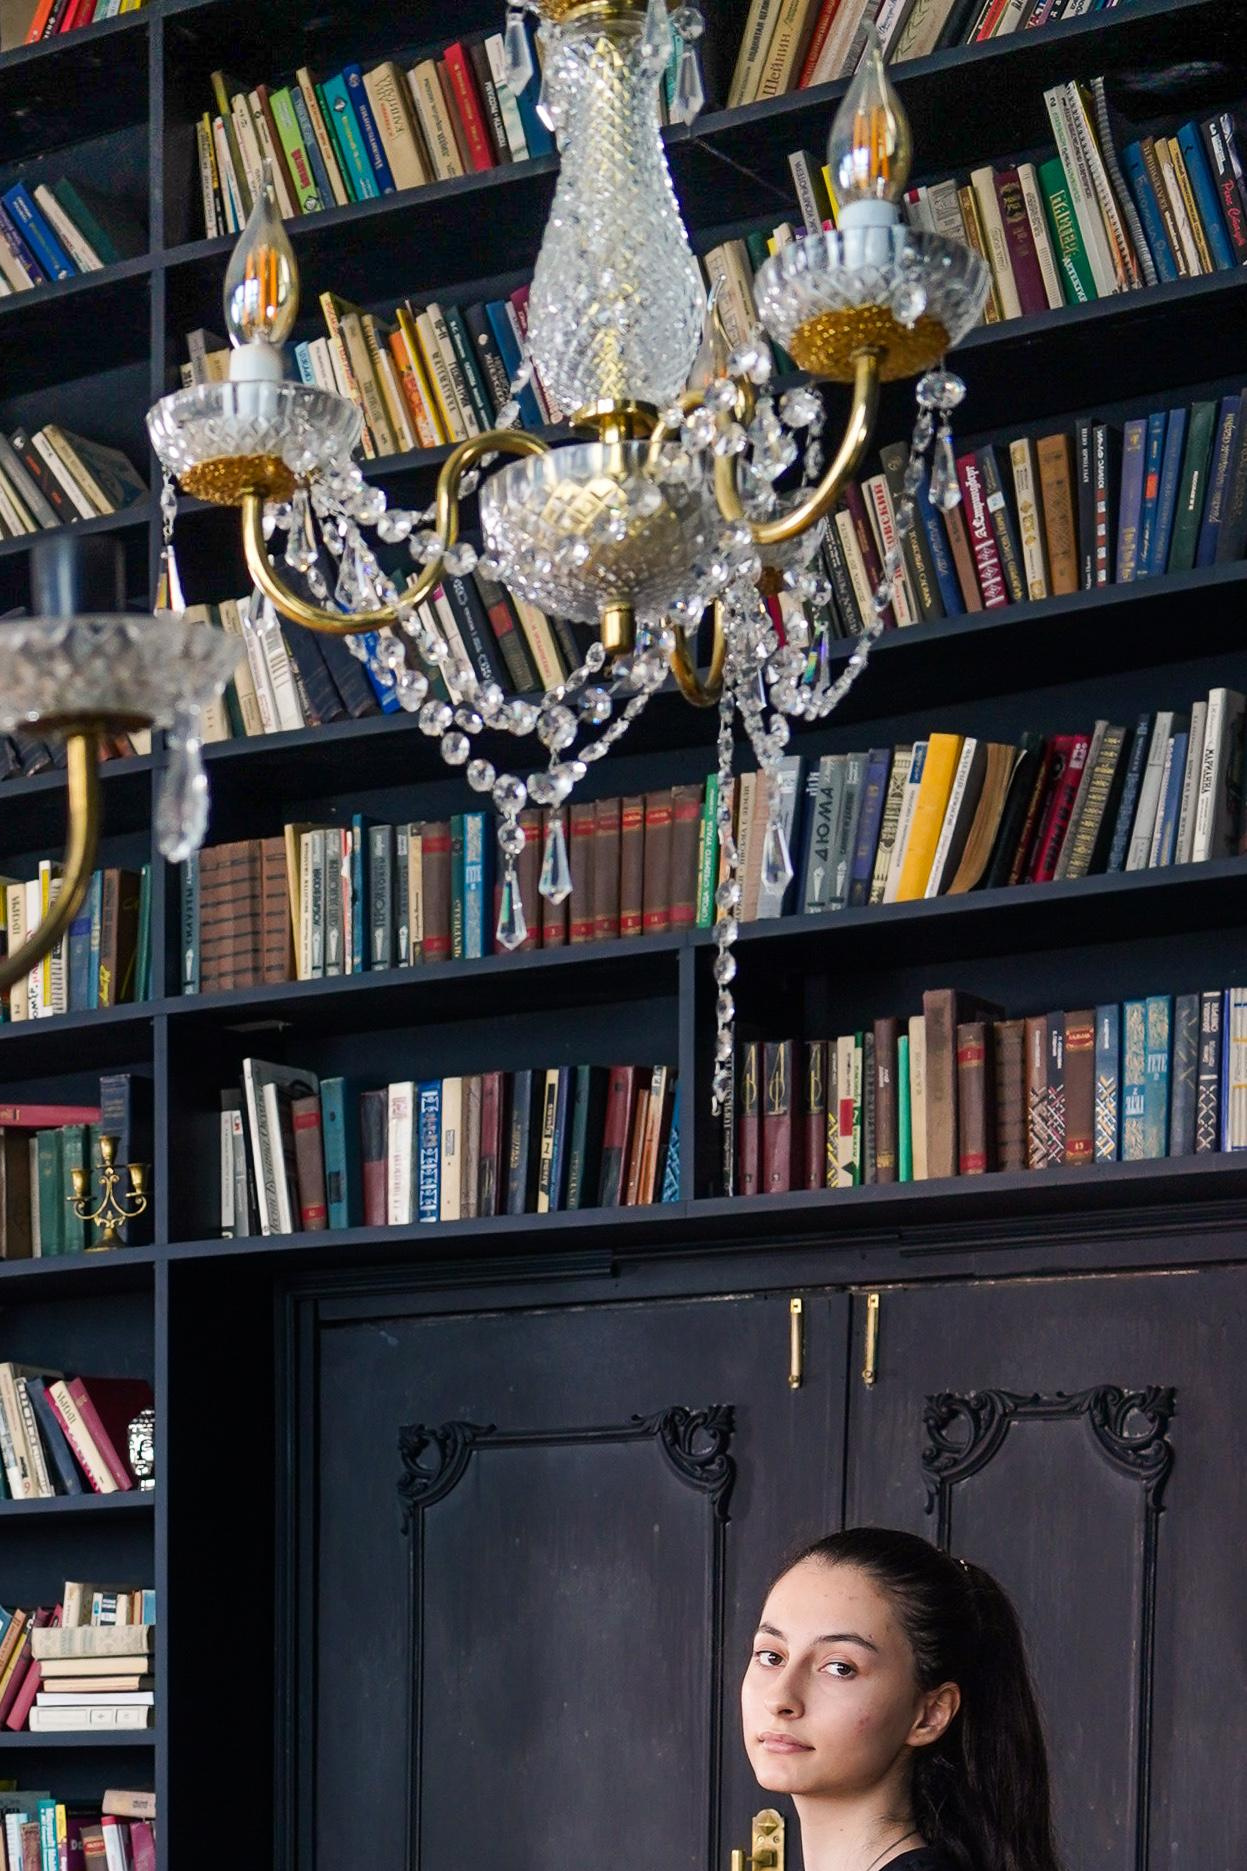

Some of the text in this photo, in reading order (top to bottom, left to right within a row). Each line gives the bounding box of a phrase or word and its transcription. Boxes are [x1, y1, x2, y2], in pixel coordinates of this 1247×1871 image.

[762, 32, 791, 97] Шейнин
[1201, 747, 1214, 794] МАРИАННА
[813, 785, 834, 862] ДЮМА
